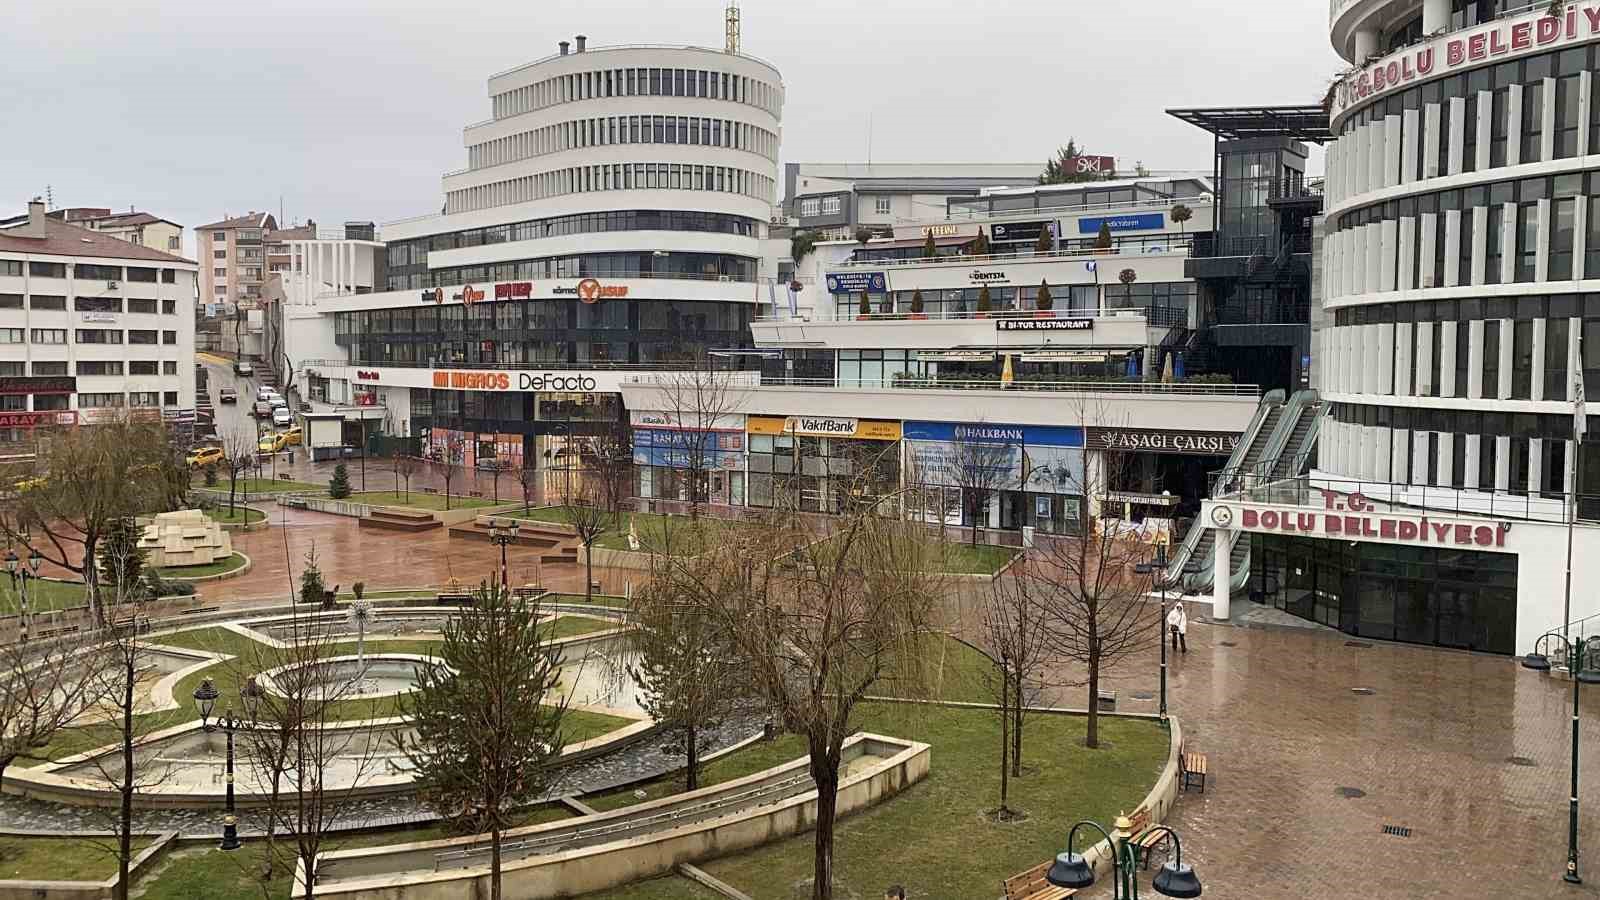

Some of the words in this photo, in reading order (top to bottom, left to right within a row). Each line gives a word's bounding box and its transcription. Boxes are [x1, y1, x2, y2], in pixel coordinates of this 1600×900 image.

[1035, 320, 1089, 329] RESTAURANT
[519, 373, 597, 391] DeFacto
[967, 427, 1023, 440] HALKBANK
[1119, 432, 1167, 450] AŞAĞI
[1173, 435, 1224, 453] ÇARŞI
[1321, 490, 1375, 513] T.C.
[1242, 509, 1316, 533] BOLU
[1325, 516, 1506, 547] BELEDİYESİ
